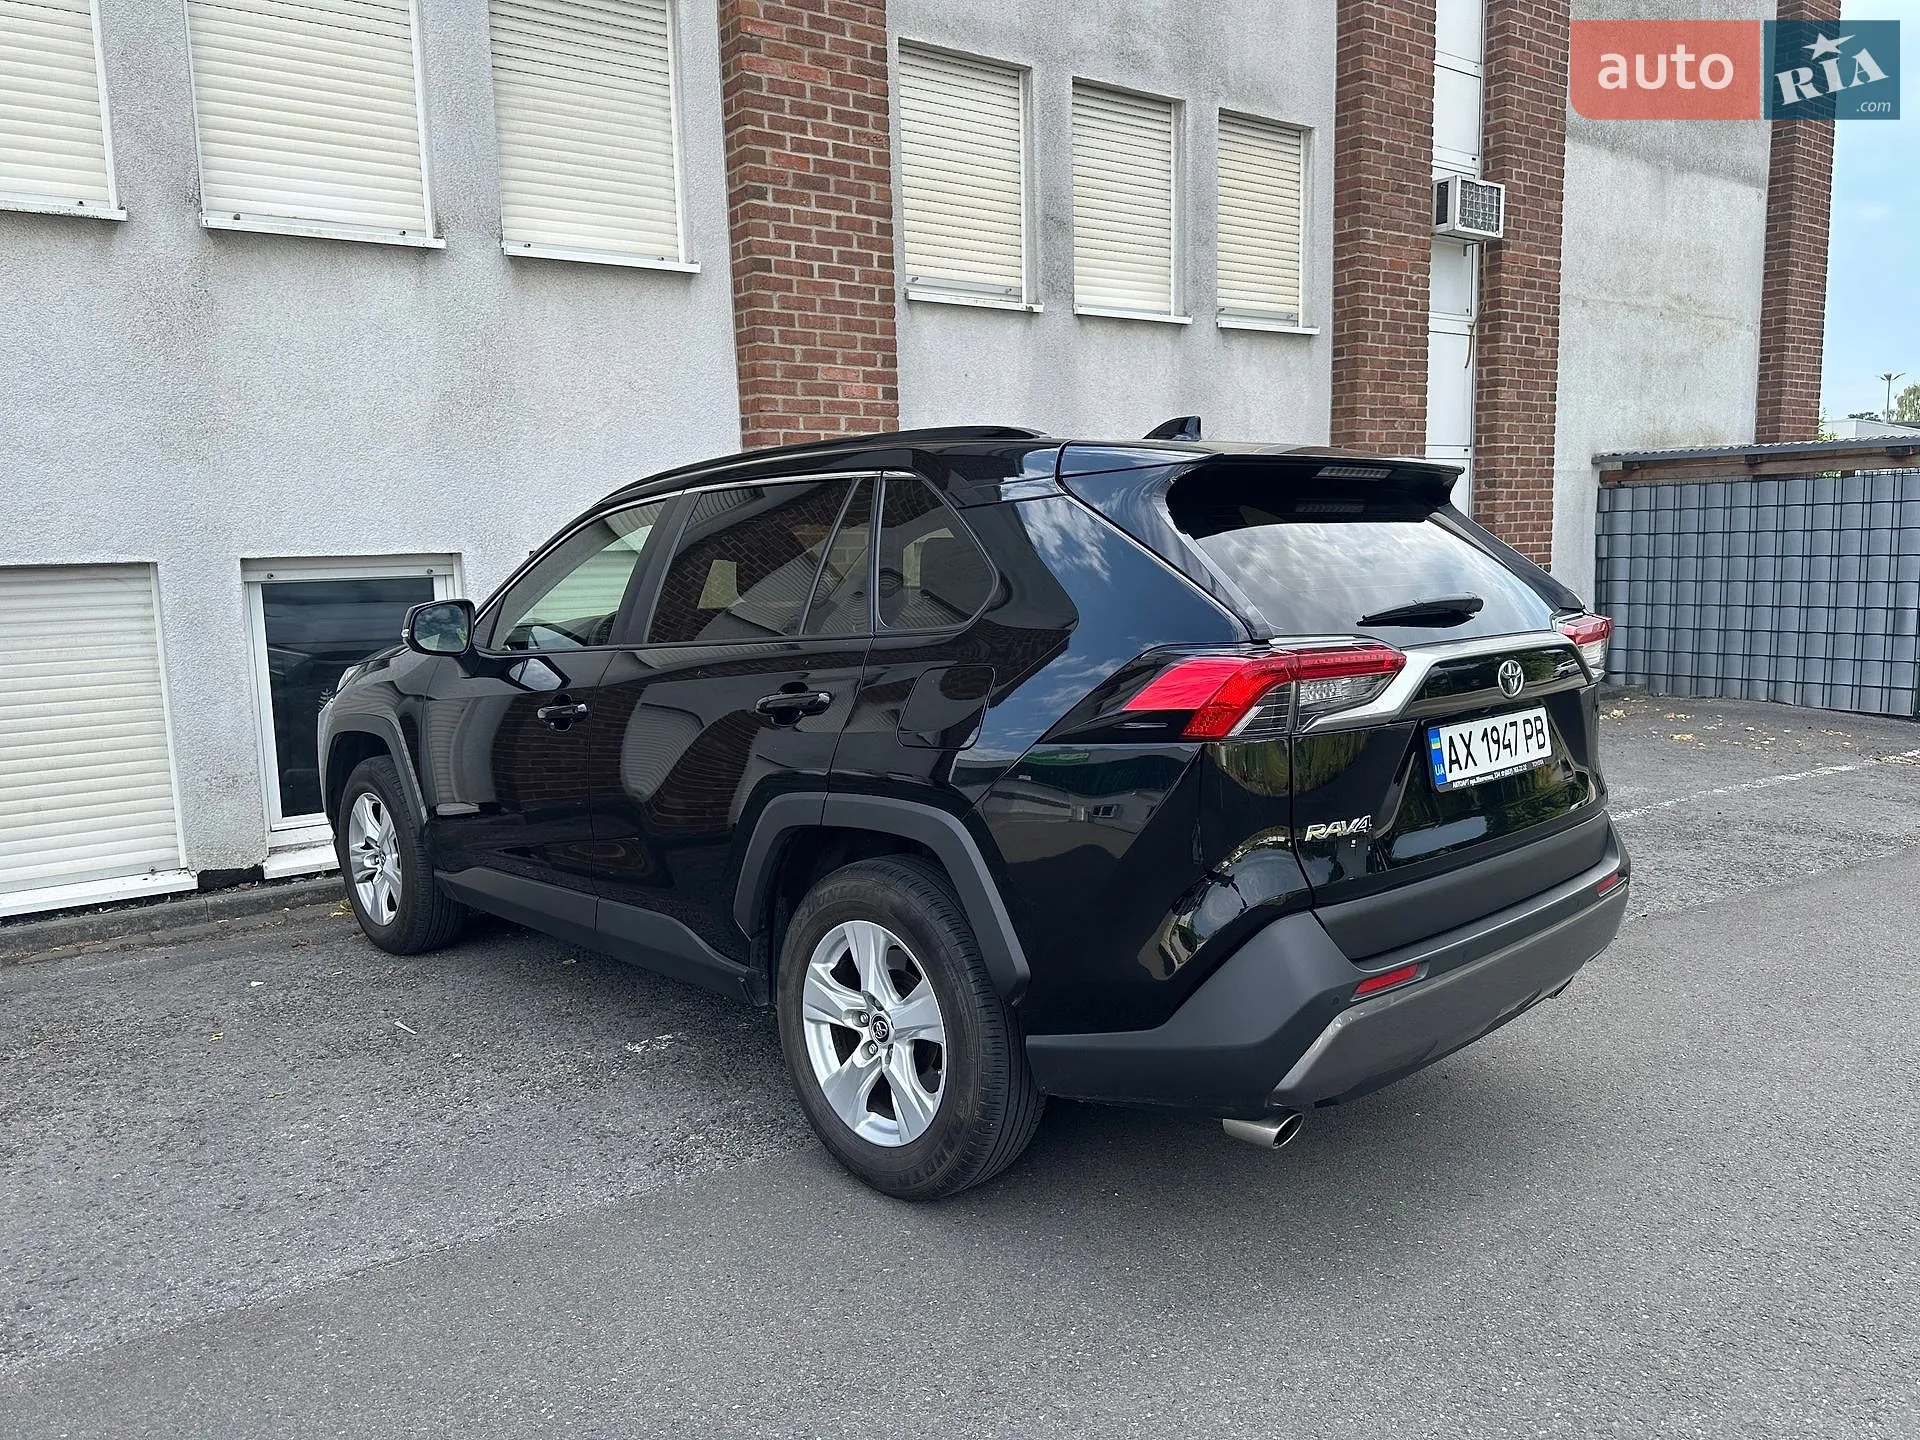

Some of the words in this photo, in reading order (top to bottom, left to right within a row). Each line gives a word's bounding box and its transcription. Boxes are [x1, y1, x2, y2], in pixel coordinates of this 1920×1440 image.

[1448, 731, 1477, 773] AX
[1481, 721, 1518, 763] 1947
[1522, 716, 1546, 754] PB
[1434, 764, 1445, 776] UA
[1304, 815, 1373, 841] RAV4
